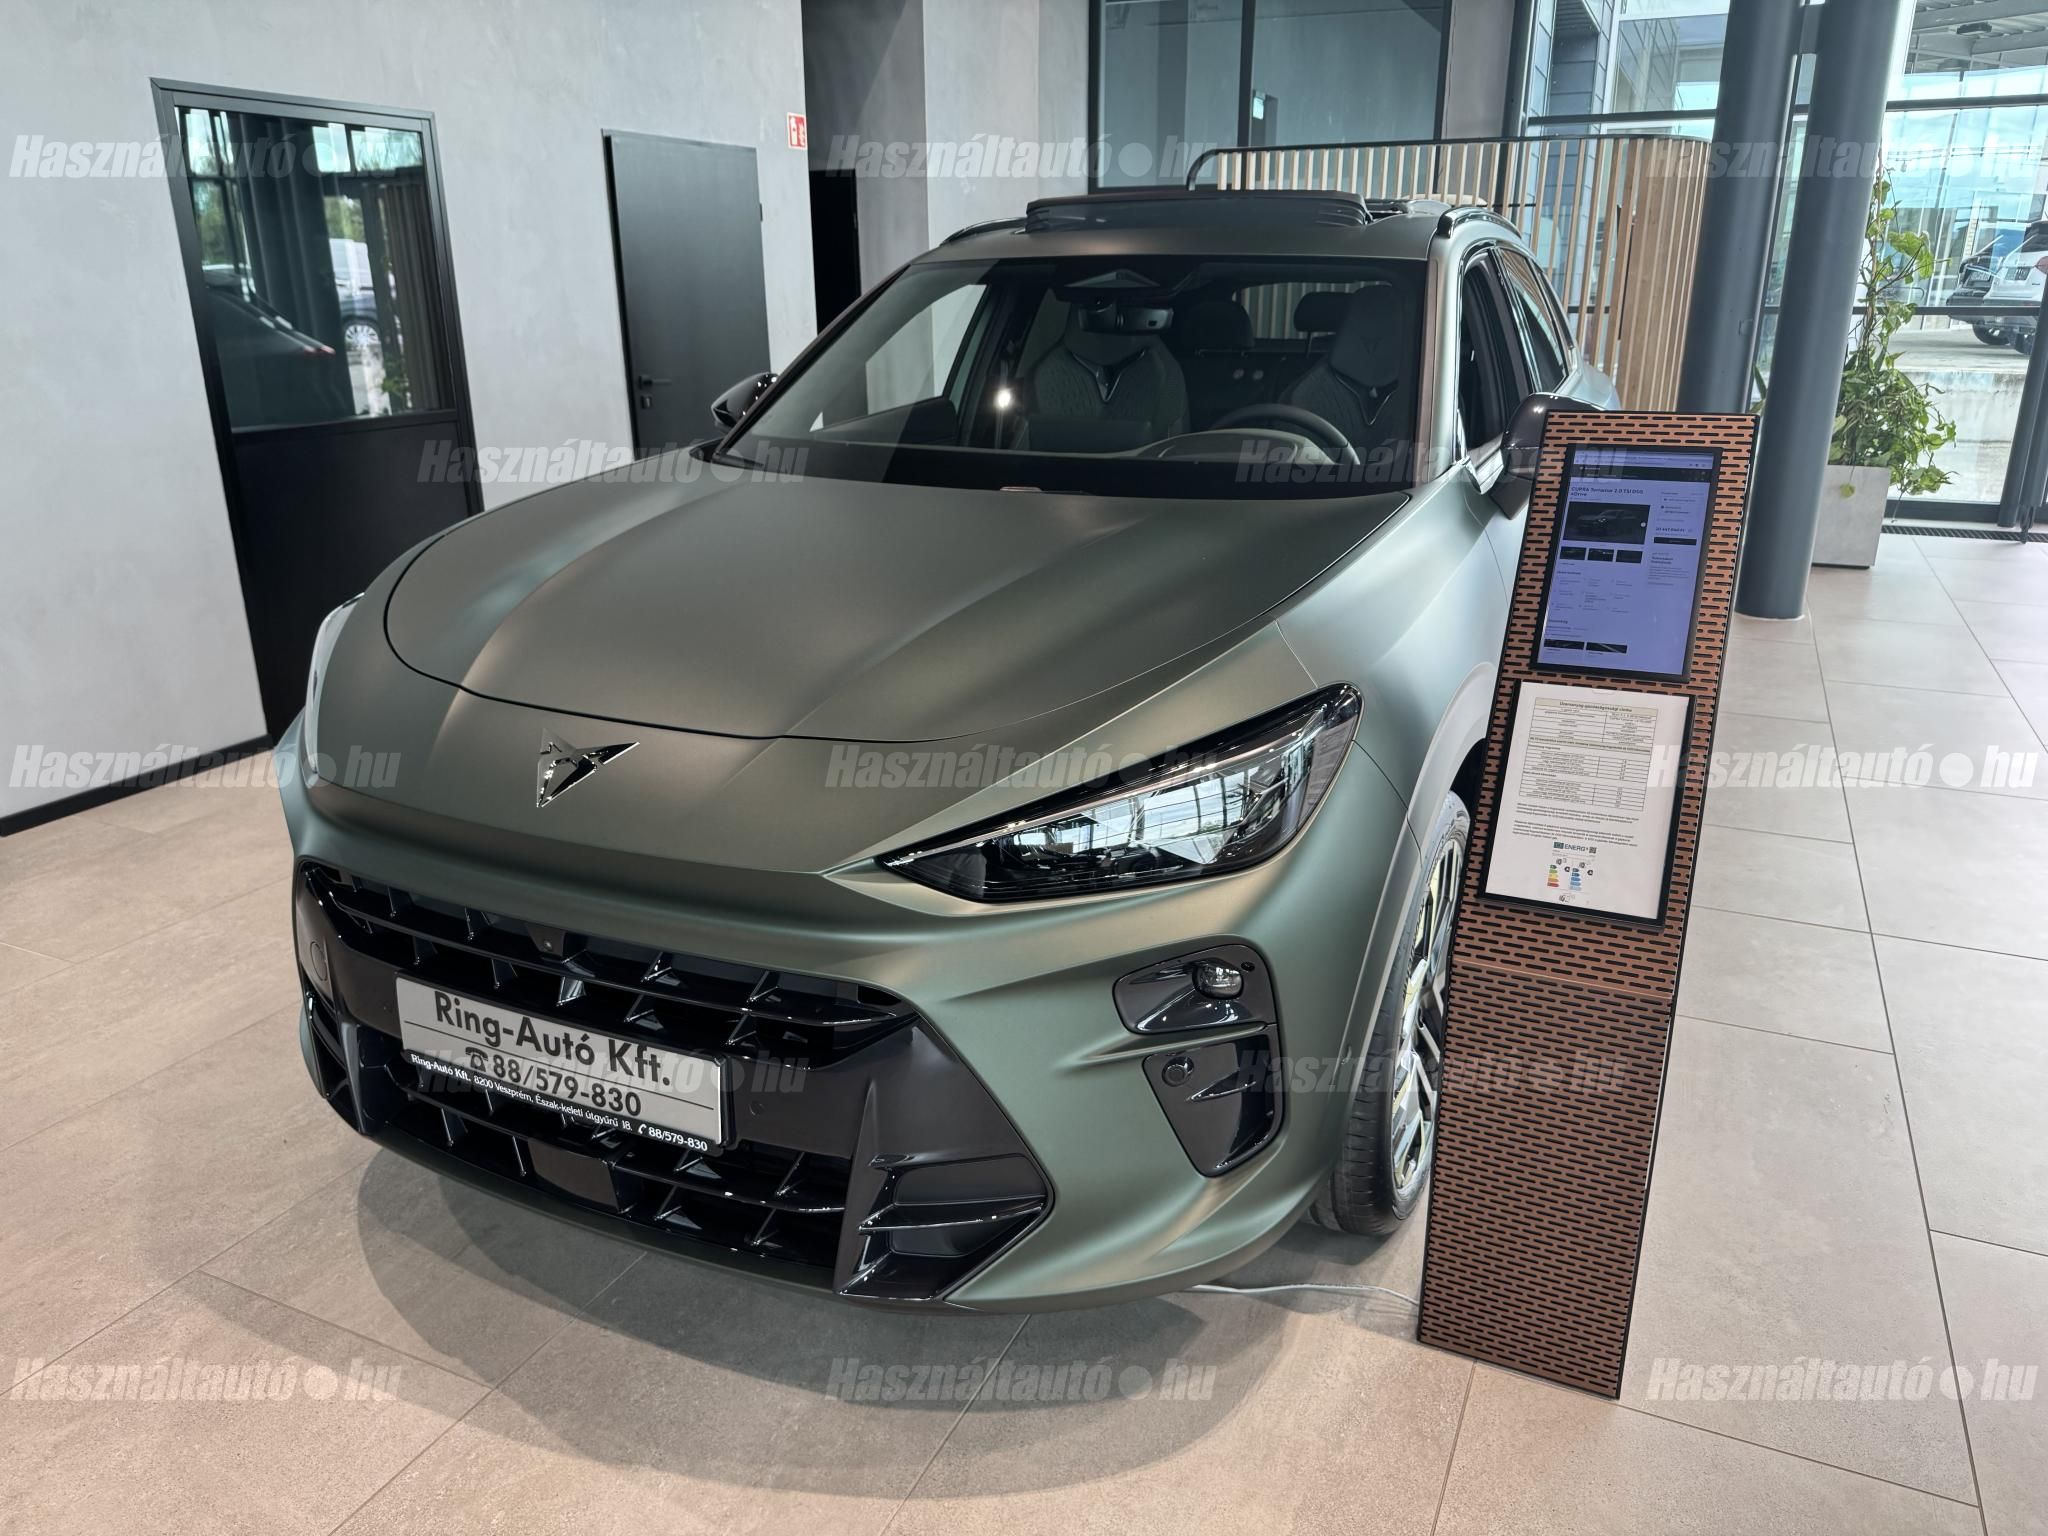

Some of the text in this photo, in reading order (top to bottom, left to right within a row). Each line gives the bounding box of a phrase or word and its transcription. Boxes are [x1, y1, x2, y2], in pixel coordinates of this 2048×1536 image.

[433, 990, 672, 1087] Ring-Autó Kft.
[492, 1052, 642, 1117] 88/579-830
[410, 1054, 454, 1076] Ring-Autó
[453, 1066, 472, 1083] Kft.
[473, 1075, 494, 1089] 8200
[535, 1091, 584, 1119] Észak-keleti
[647, 1125, 708, 1152] 88/579-830
